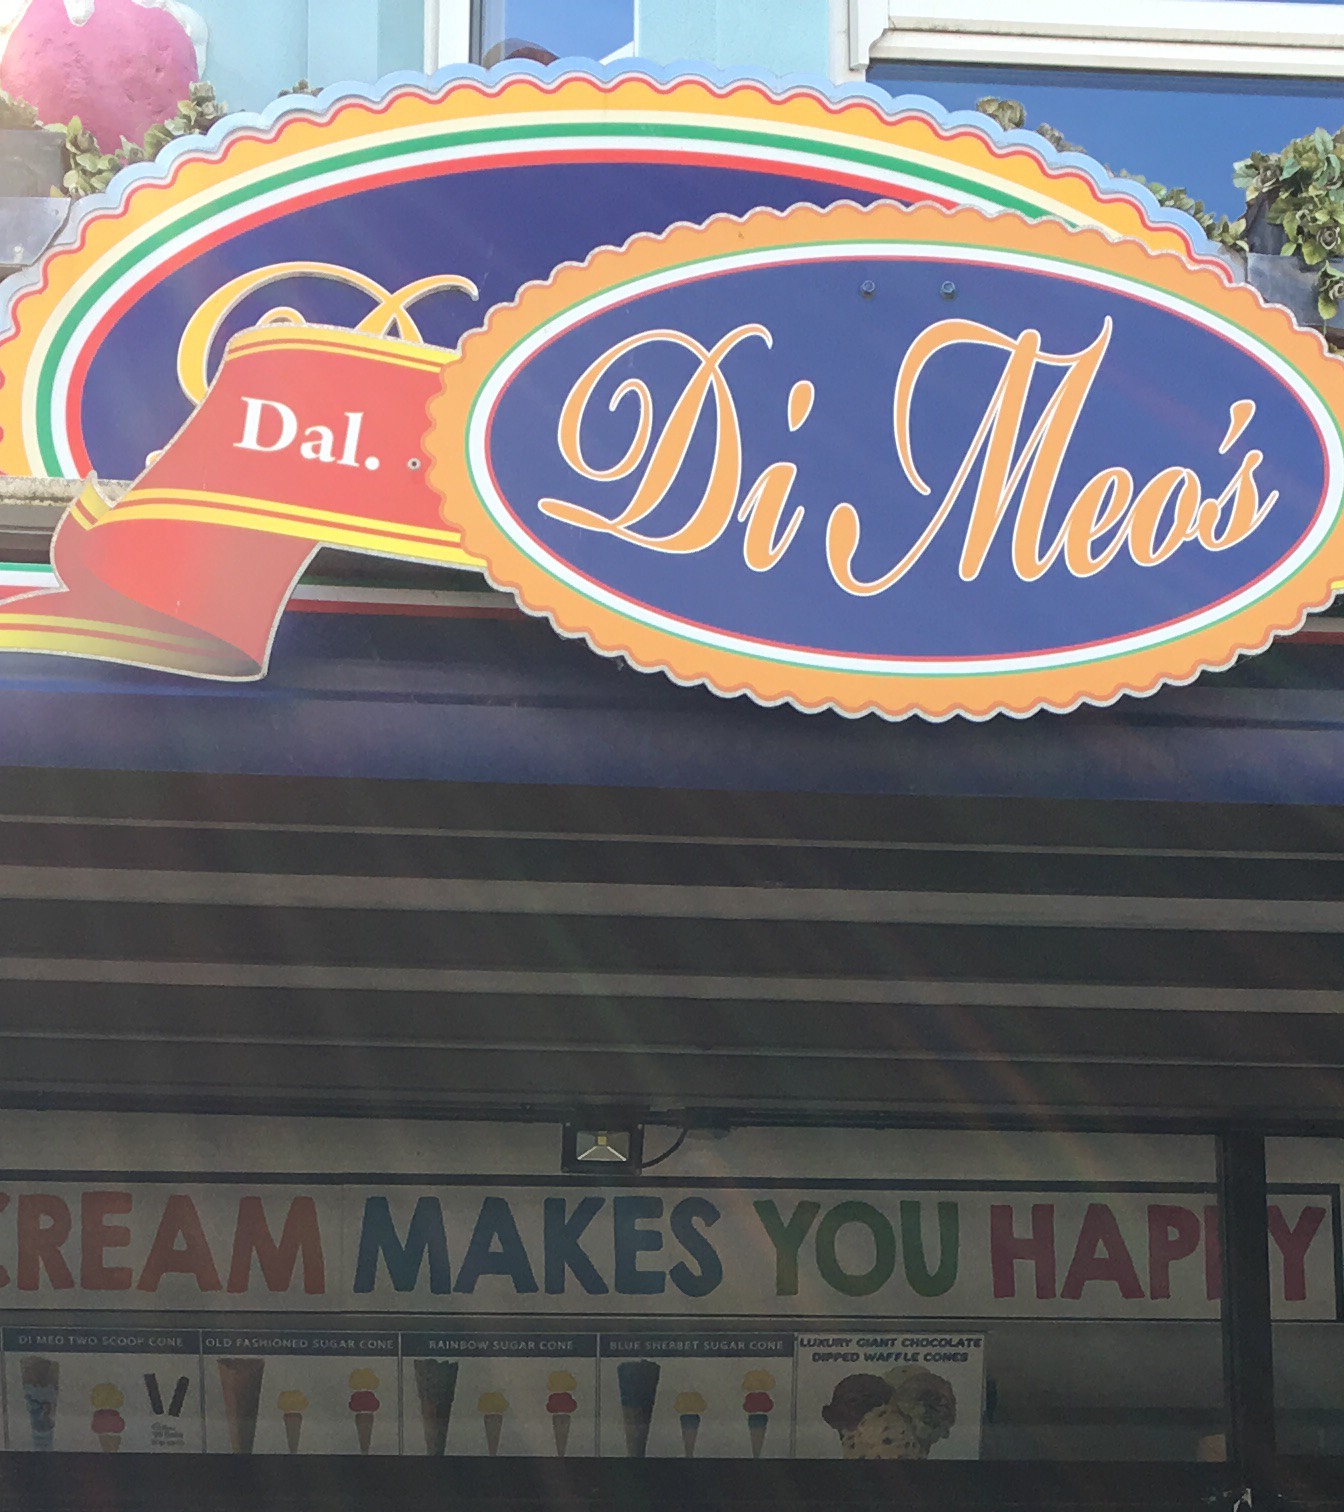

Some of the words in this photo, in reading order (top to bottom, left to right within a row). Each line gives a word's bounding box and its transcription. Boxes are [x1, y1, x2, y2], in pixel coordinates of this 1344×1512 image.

[235, 393, 383, 473] Dal.
[536, 317, 819, 568] Di
[824, 312, 1283, 598] Meo's
[351, 1195, 725, 1299] MAKES
[752, 1199, 961, 1299] YOU
[17, 1335, 34, 1347] DI
[35, 1335, 67, 1347] MEO
[68, 1336, 98, 1347] TWO
[101, 1336, 146, 1348] SCOOP
[148, 1337, 183, 1348] CONE
[204, 1337, 233, 1348] OLD
[235, 1337, 309, 1349] FASHIONED
[312, 1338, 356, 1349] SUGAR
[358, 1339, 395, 1350] CONE
[428, 1339, 490, 1351] RAINBOW
[492, 1339, 535, 1351] SUGAR
[538, 1339, 574, 1351] CONE
[609, 1339, 641, 1351] BLUE
[702, 1340, 746, 1351] SUGAR
[749, 1340, 784, 1351] CONE
[799, 1336, 853, 1349] LUXURY
[855, 1336, 898, 1349] GIANT
[900, 1336, 983, 1349] CHOCOLATE
[811, 1351, 859, 1364] DIPPED
[862, 1351, 921, 1364] WAFFLE
[923, 1351, 970, 1364] CONES
